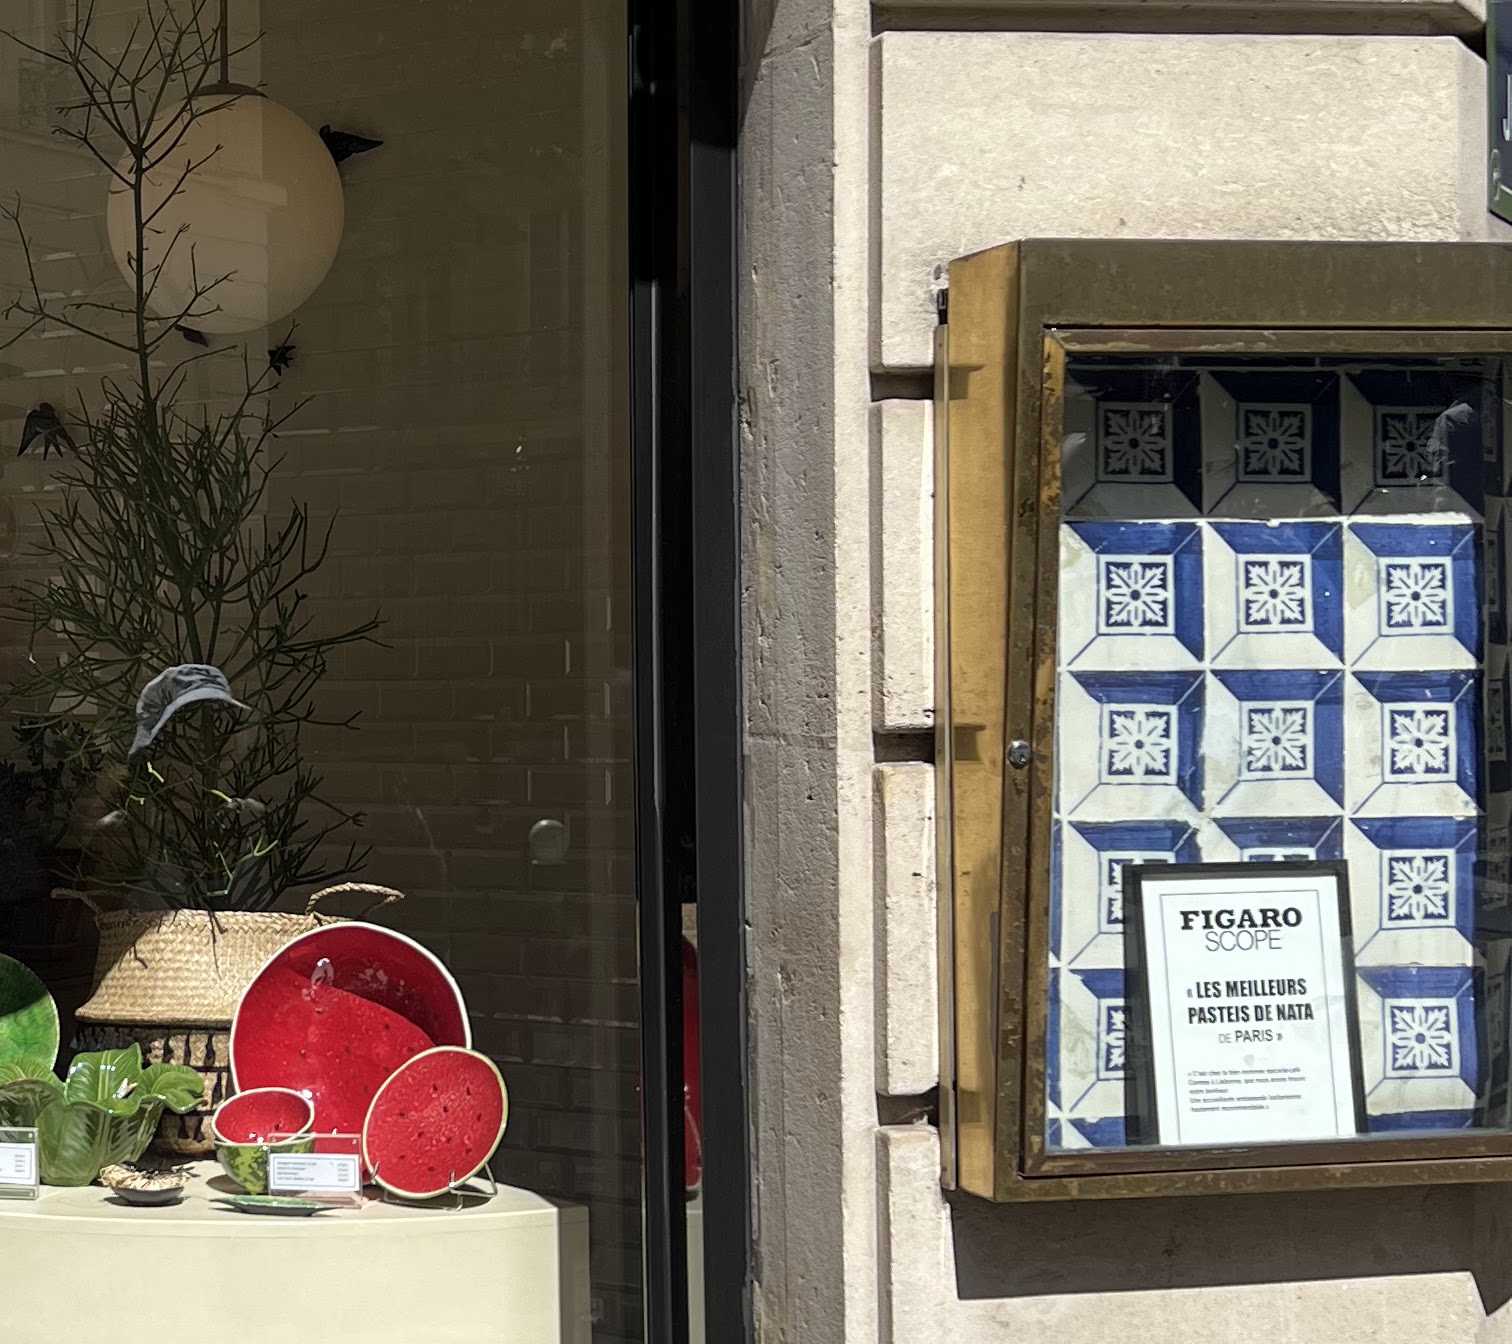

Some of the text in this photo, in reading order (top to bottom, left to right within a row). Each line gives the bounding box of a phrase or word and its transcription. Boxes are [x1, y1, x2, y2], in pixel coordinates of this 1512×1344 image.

[1180, 907, 1302, 931] FIGARO
[1203, 929, 1283, 951] SCOPE
[1196, 981, 1221, 999] LES
[1226, 978, 1307, 998] MEILLEURS
[1188, 1003, 1314, 1024] PASTEIS DE NATA
[1235, 1029, 1273, 1043] PARIS
